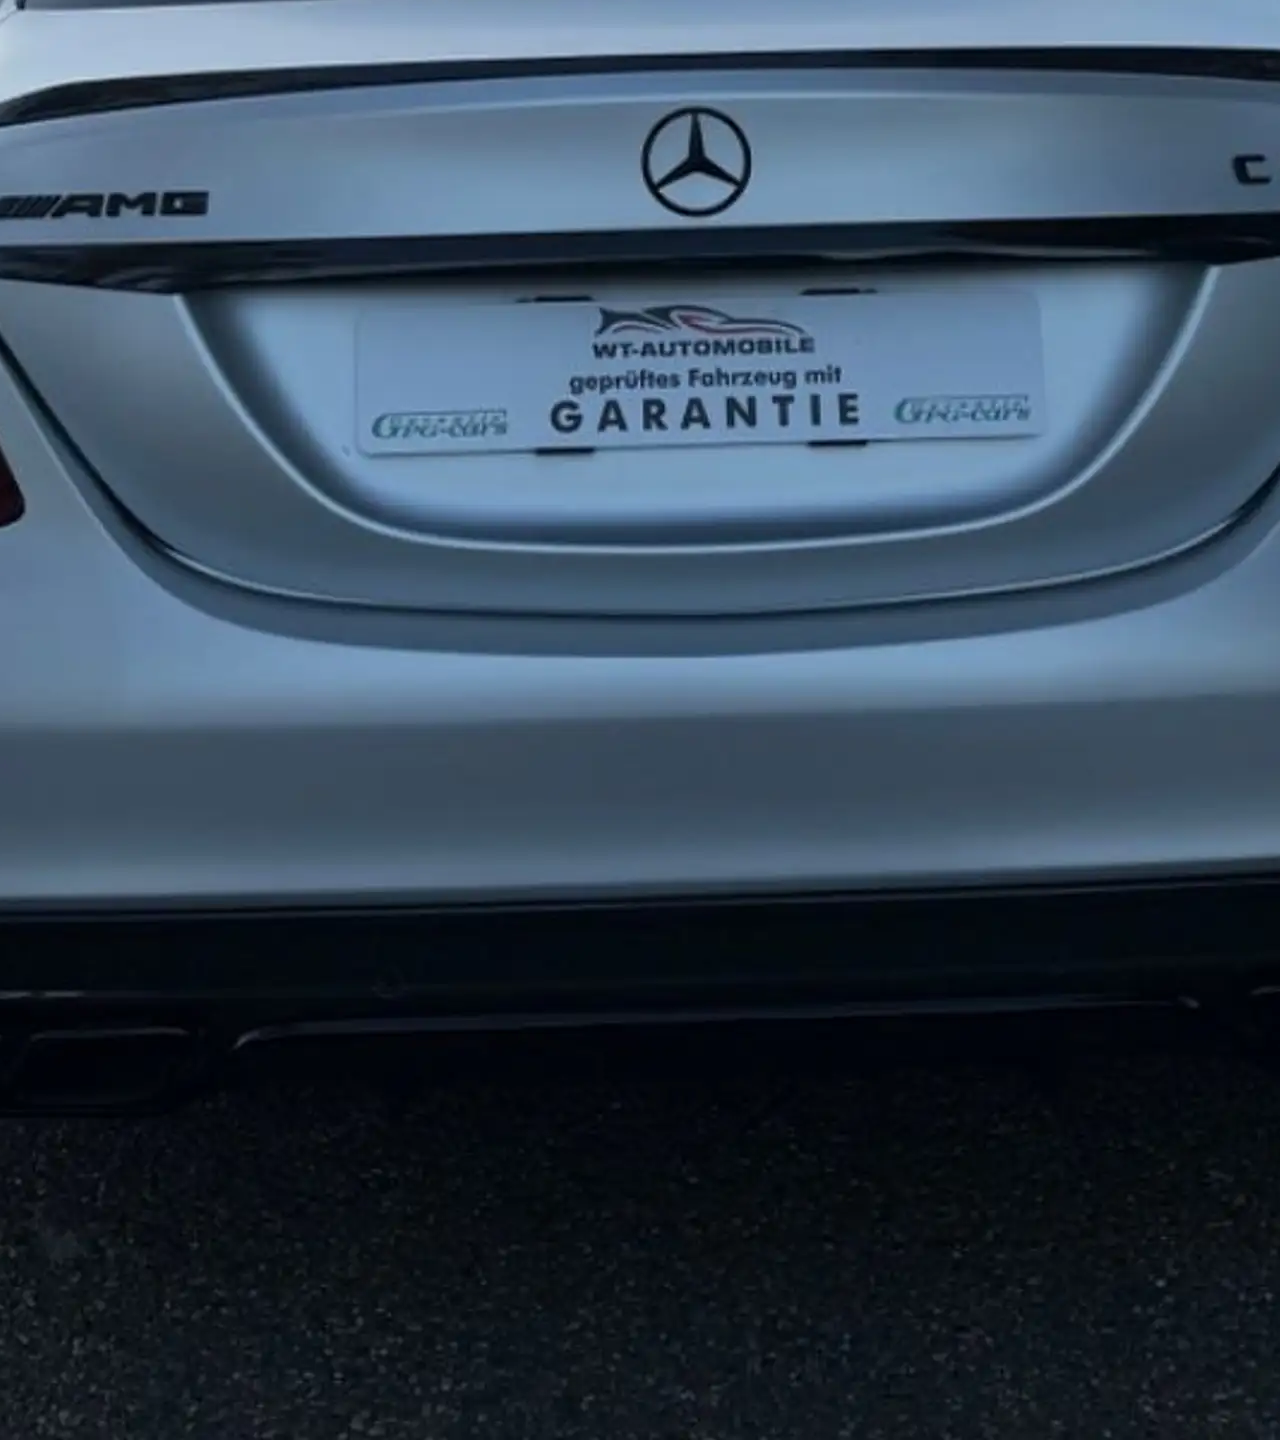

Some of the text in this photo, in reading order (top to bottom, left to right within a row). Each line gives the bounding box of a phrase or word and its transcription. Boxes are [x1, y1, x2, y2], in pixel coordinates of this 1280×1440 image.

[1232, 153, 1273, 186] C
[592, 335, 815, 359] WT-AUTOMOBILE
[568, 364, 842, 395] geprüftes Fahrzeug mit
[549, 392, 860, 434] GARANTIE
